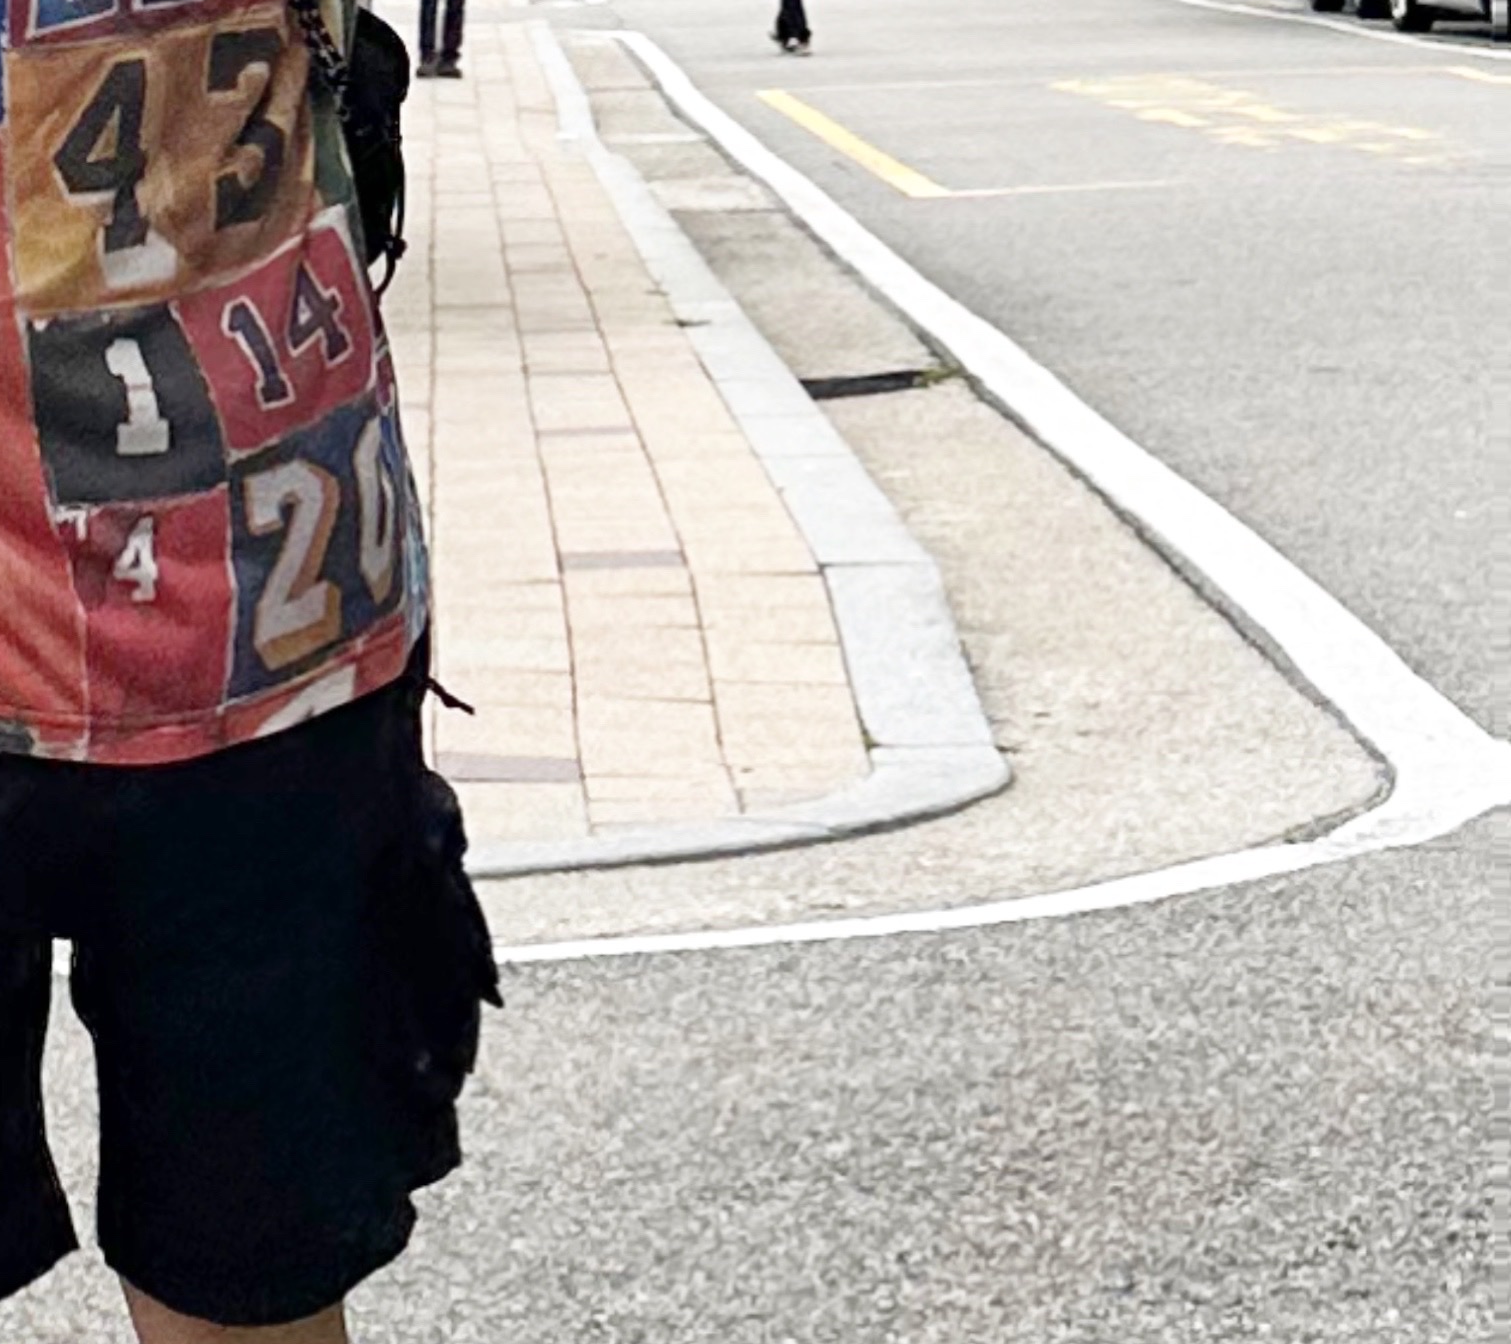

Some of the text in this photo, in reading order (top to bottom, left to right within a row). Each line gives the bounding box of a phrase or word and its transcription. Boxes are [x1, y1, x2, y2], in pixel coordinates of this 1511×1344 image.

[52, 25, 290, 288] 43
[104, 337, 170, 455] 1
[221, 261, 354, 410] 14
